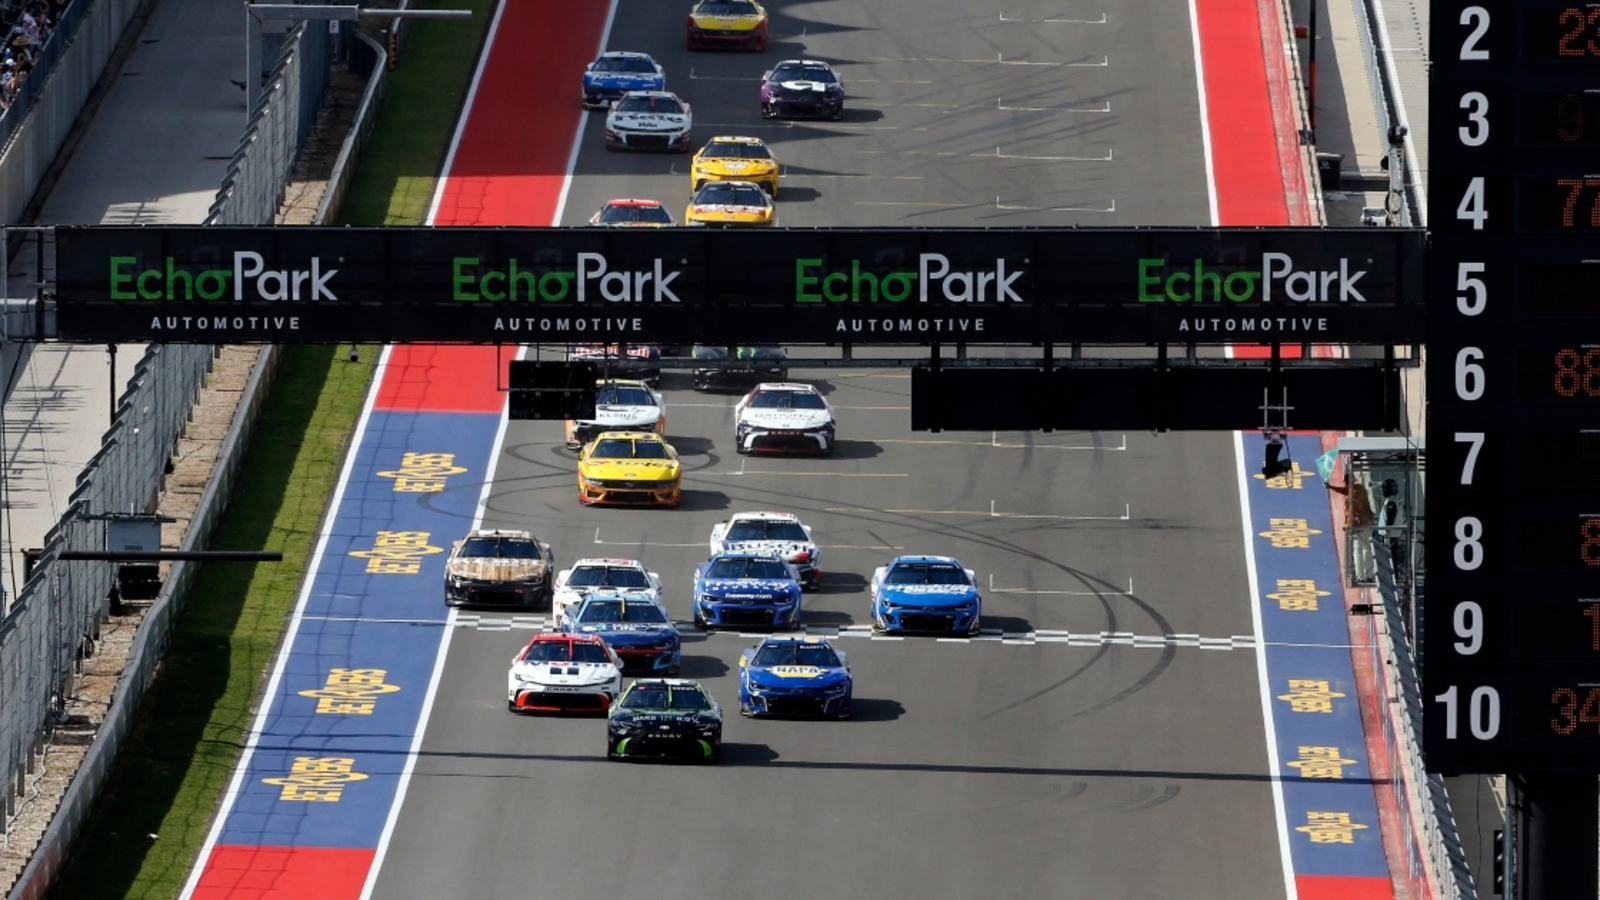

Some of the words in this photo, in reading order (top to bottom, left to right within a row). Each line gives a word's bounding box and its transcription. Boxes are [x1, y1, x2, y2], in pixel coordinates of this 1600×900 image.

[1459, 6, 1491, 60] 2
[1458, 91, 1490, 146] 3
[1456, 176, 1489, 230] 4
[111, 250, 338, 301] EchoPark
[454, 252, 681, 302] EchoPark
[797, 252, 1024, 303] EchoPark
[1139, 252, 1366, 303] EchoPark
[1456, 262, 1488, 316] 5
[151, 316, 300, 330] AUTOMOTIVE
[494, 317, 642, 331] AUTOMOTIVE
[836, 318, 984, 332] AUTOMOTIVE
[1179, 318, 1327, 332] AUTOMOTIVE
[1454, 346, 1486, 401] 6
[1454, 432, 1485, 485] 7
[1453, 516, 1484, 571] 8
[1453, 600, 1484, 655] 9
[776, 666, 818, 674] NAPA
[1435, 685, 1500, 740] 10
[1551, 687, 1600, 735] 34
